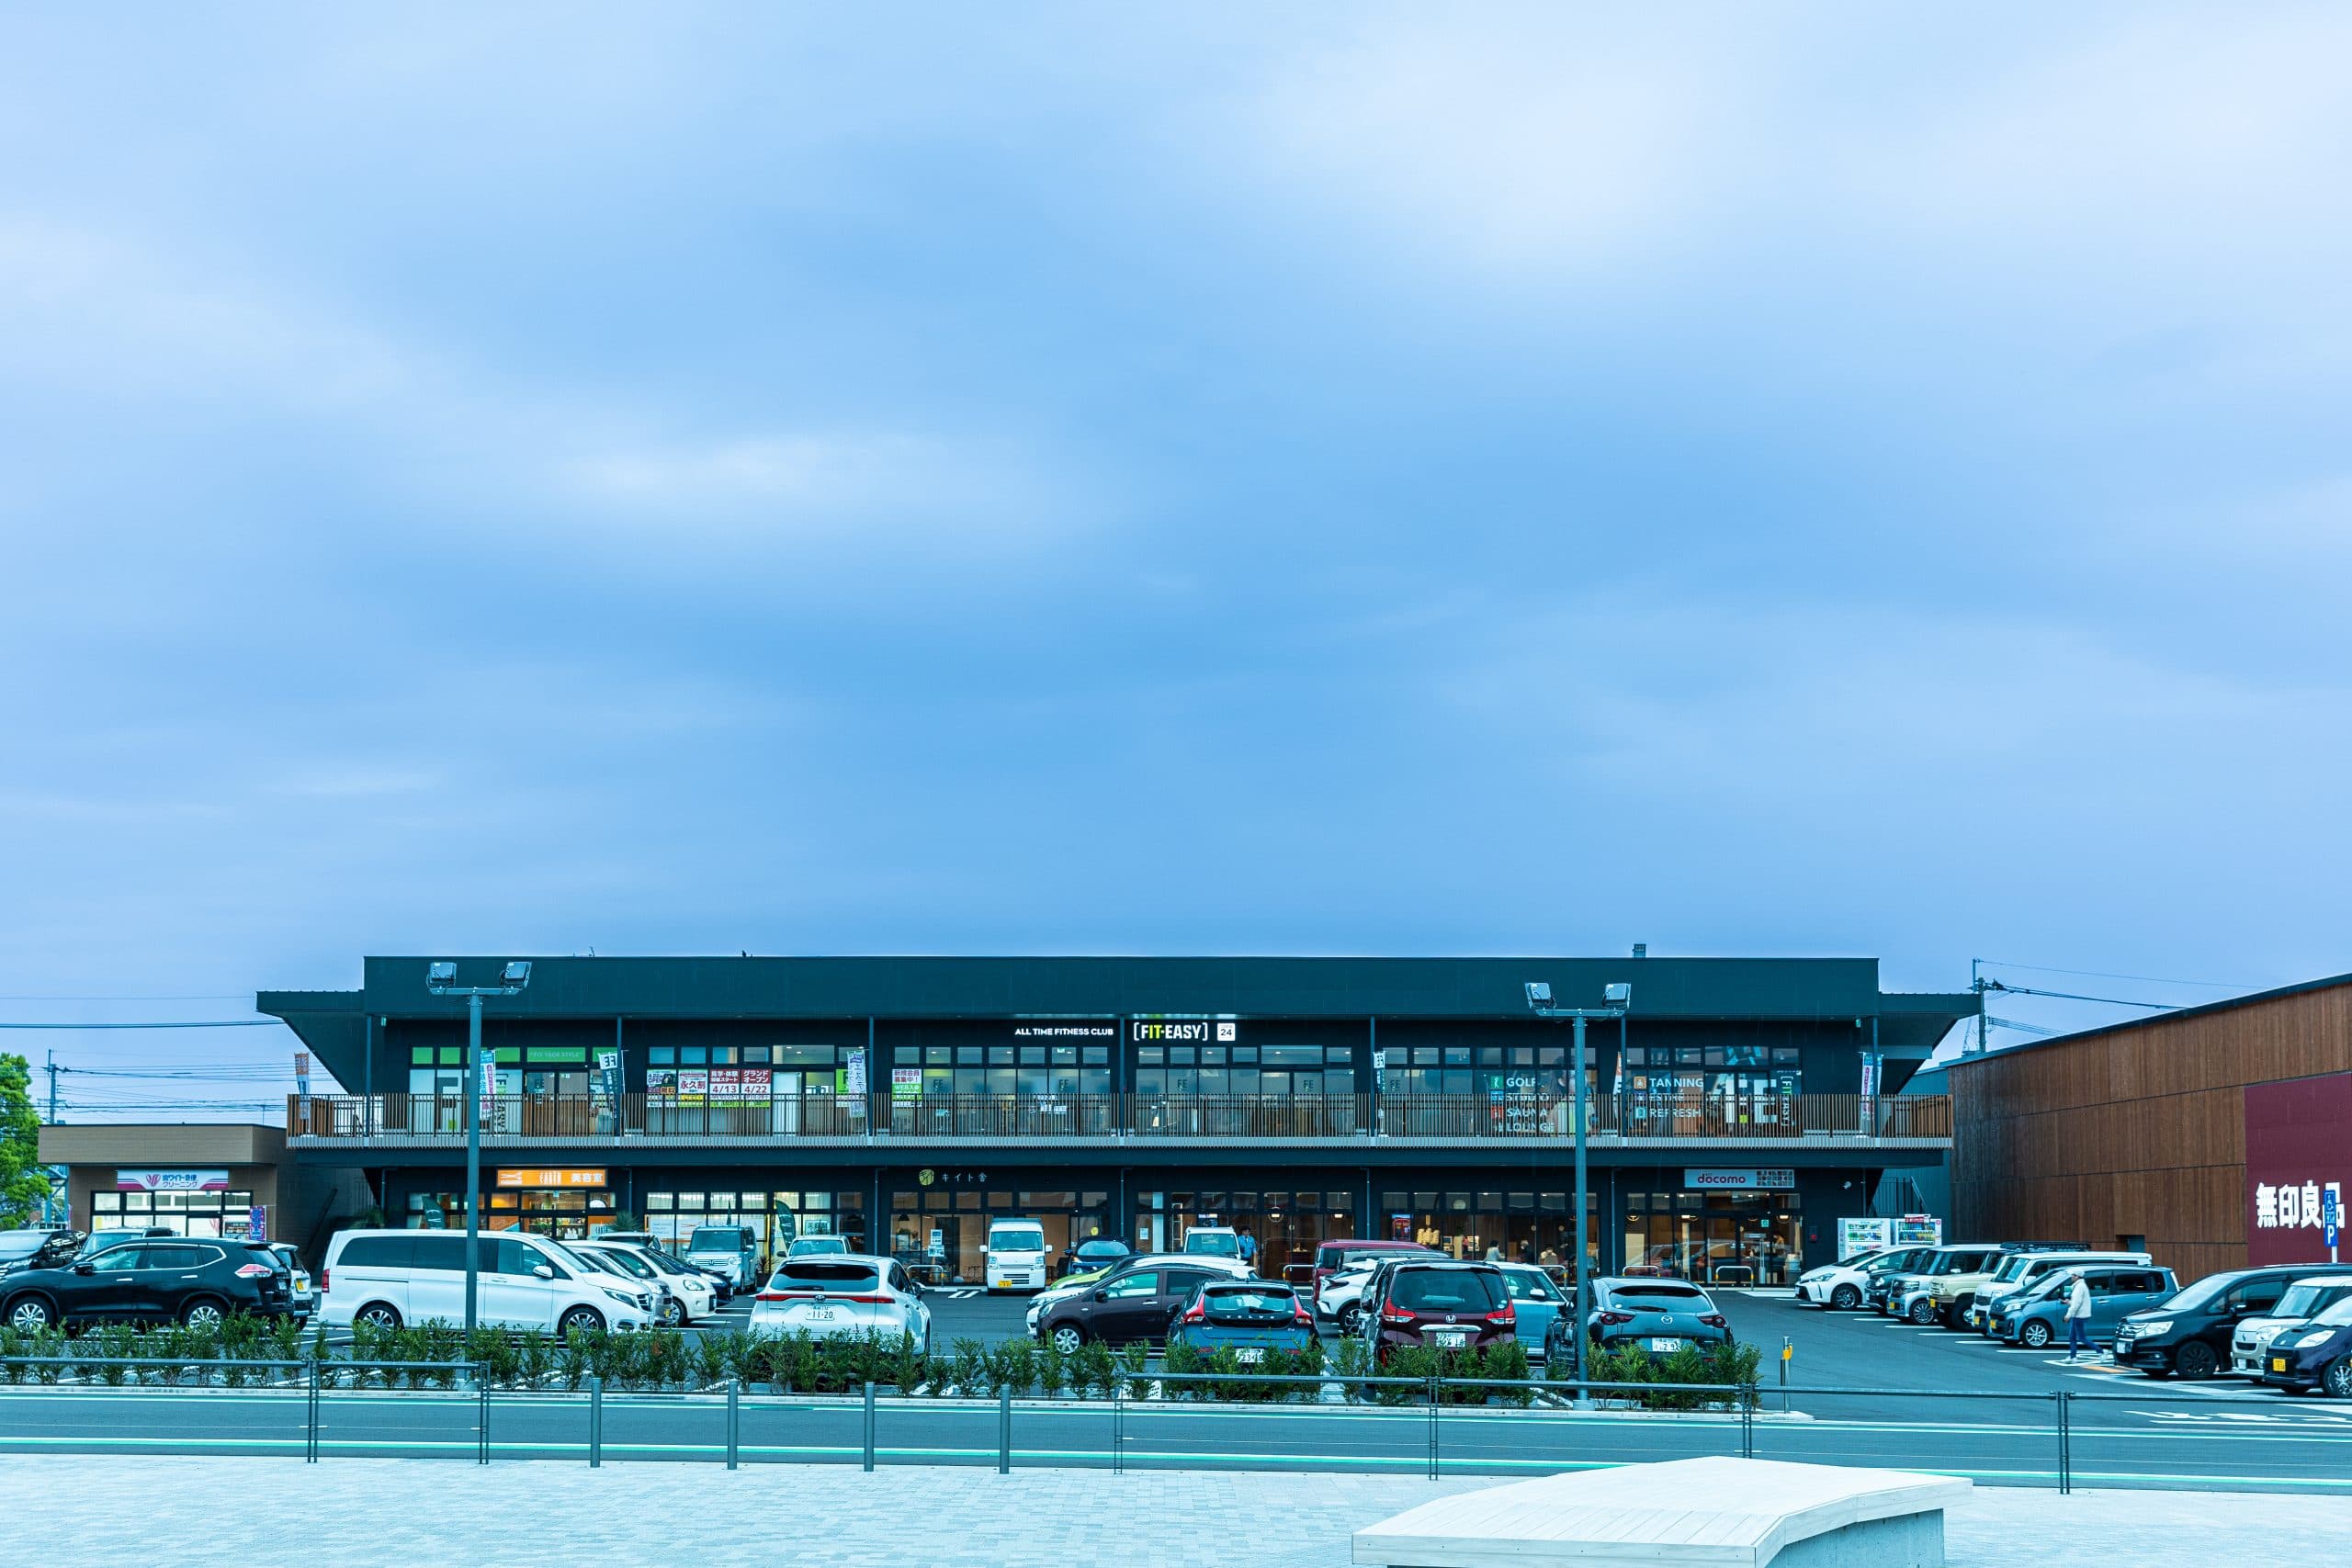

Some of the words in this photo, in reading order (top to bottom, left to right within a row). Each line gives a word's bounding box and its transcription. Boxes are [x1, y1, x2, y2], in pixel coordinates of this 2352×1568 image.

[1014, 1028, 1032, 1036] ALL
[1033, 1028, 1053, 1036] TIME
[1054, 1028, 1090, 1036] FITNESS
[1091, 1028, 1114, 1036] CLUB
[1220, 1028, 1232, 1036] 24
[1507, 1077, 1536, 1088] GOLF
[1649, 1077, 1704, 1088] TANNING
[712, 1085, 737, 1093] 4/13
[744, 1085, 768, 1094] 4/22
[1507, 1092, 1550, 1101] STUDO
[1697, 1173, 1747, 1184] docomo
[2327, 1224, 2335, 1245] P
